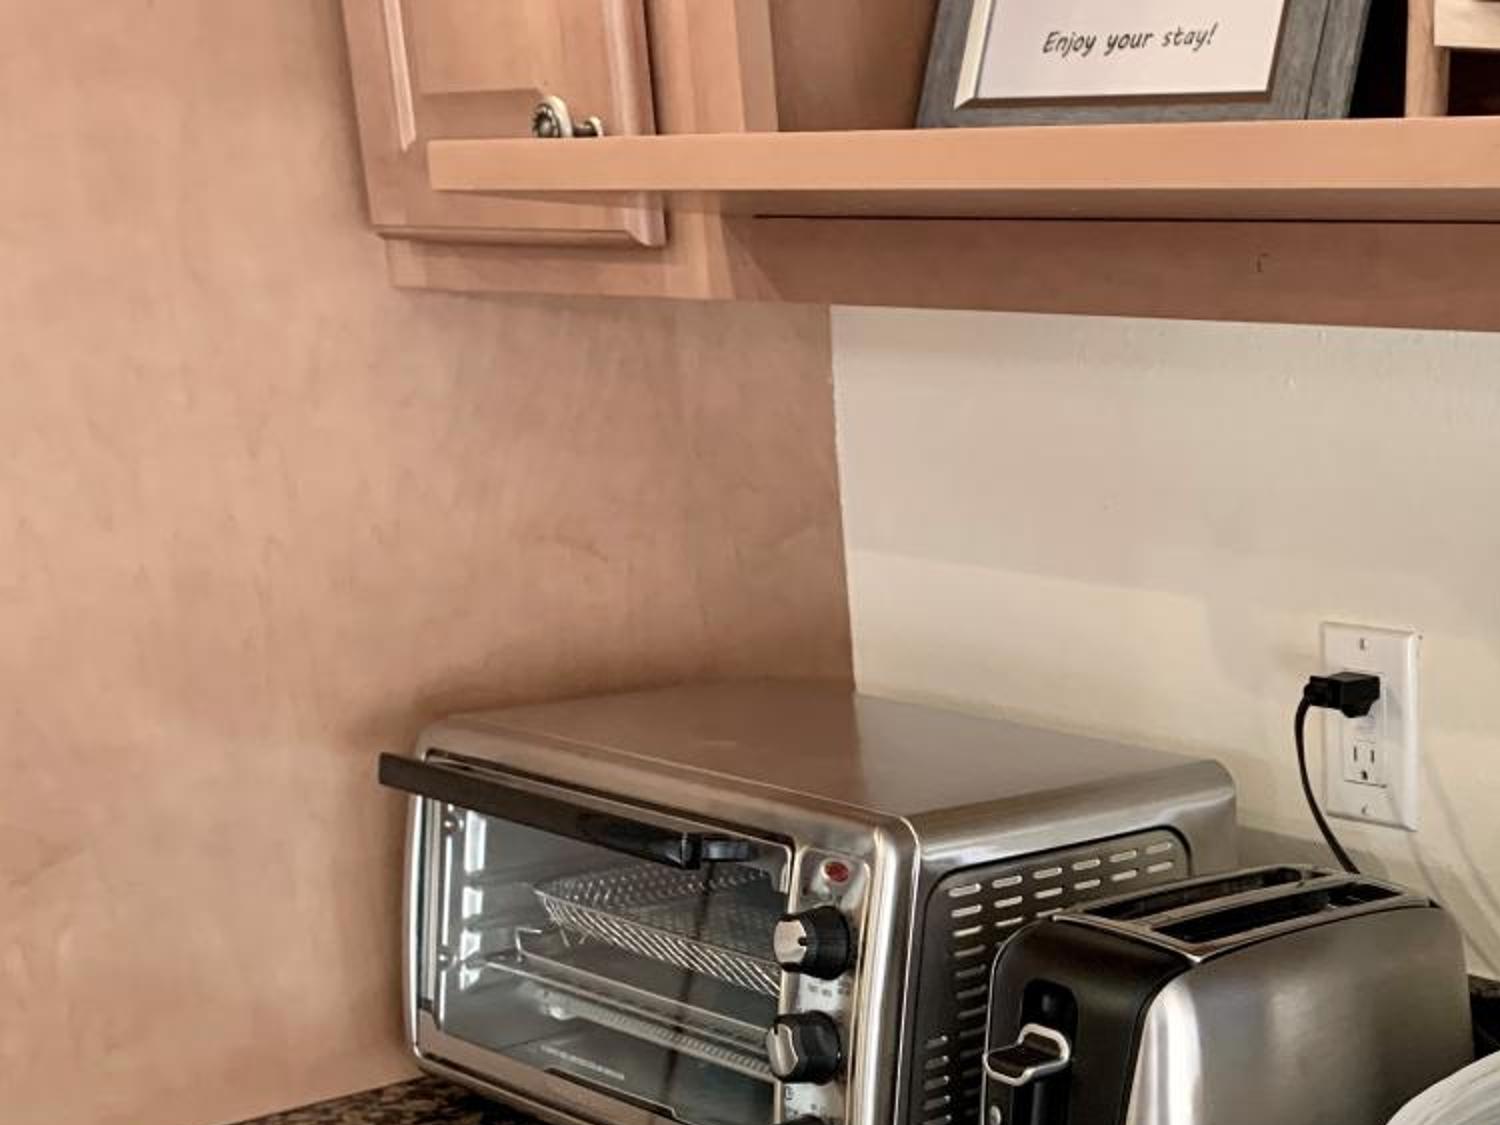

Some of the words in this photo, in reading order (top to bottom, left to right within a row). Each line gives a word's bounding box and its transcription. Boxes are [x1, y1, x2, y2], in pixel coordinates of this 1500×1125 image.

[1042, 30, 1097, 58] Enjoy
[1103, 31, 1154, 56] your
[1161, 21, 1219, 52] stay!
